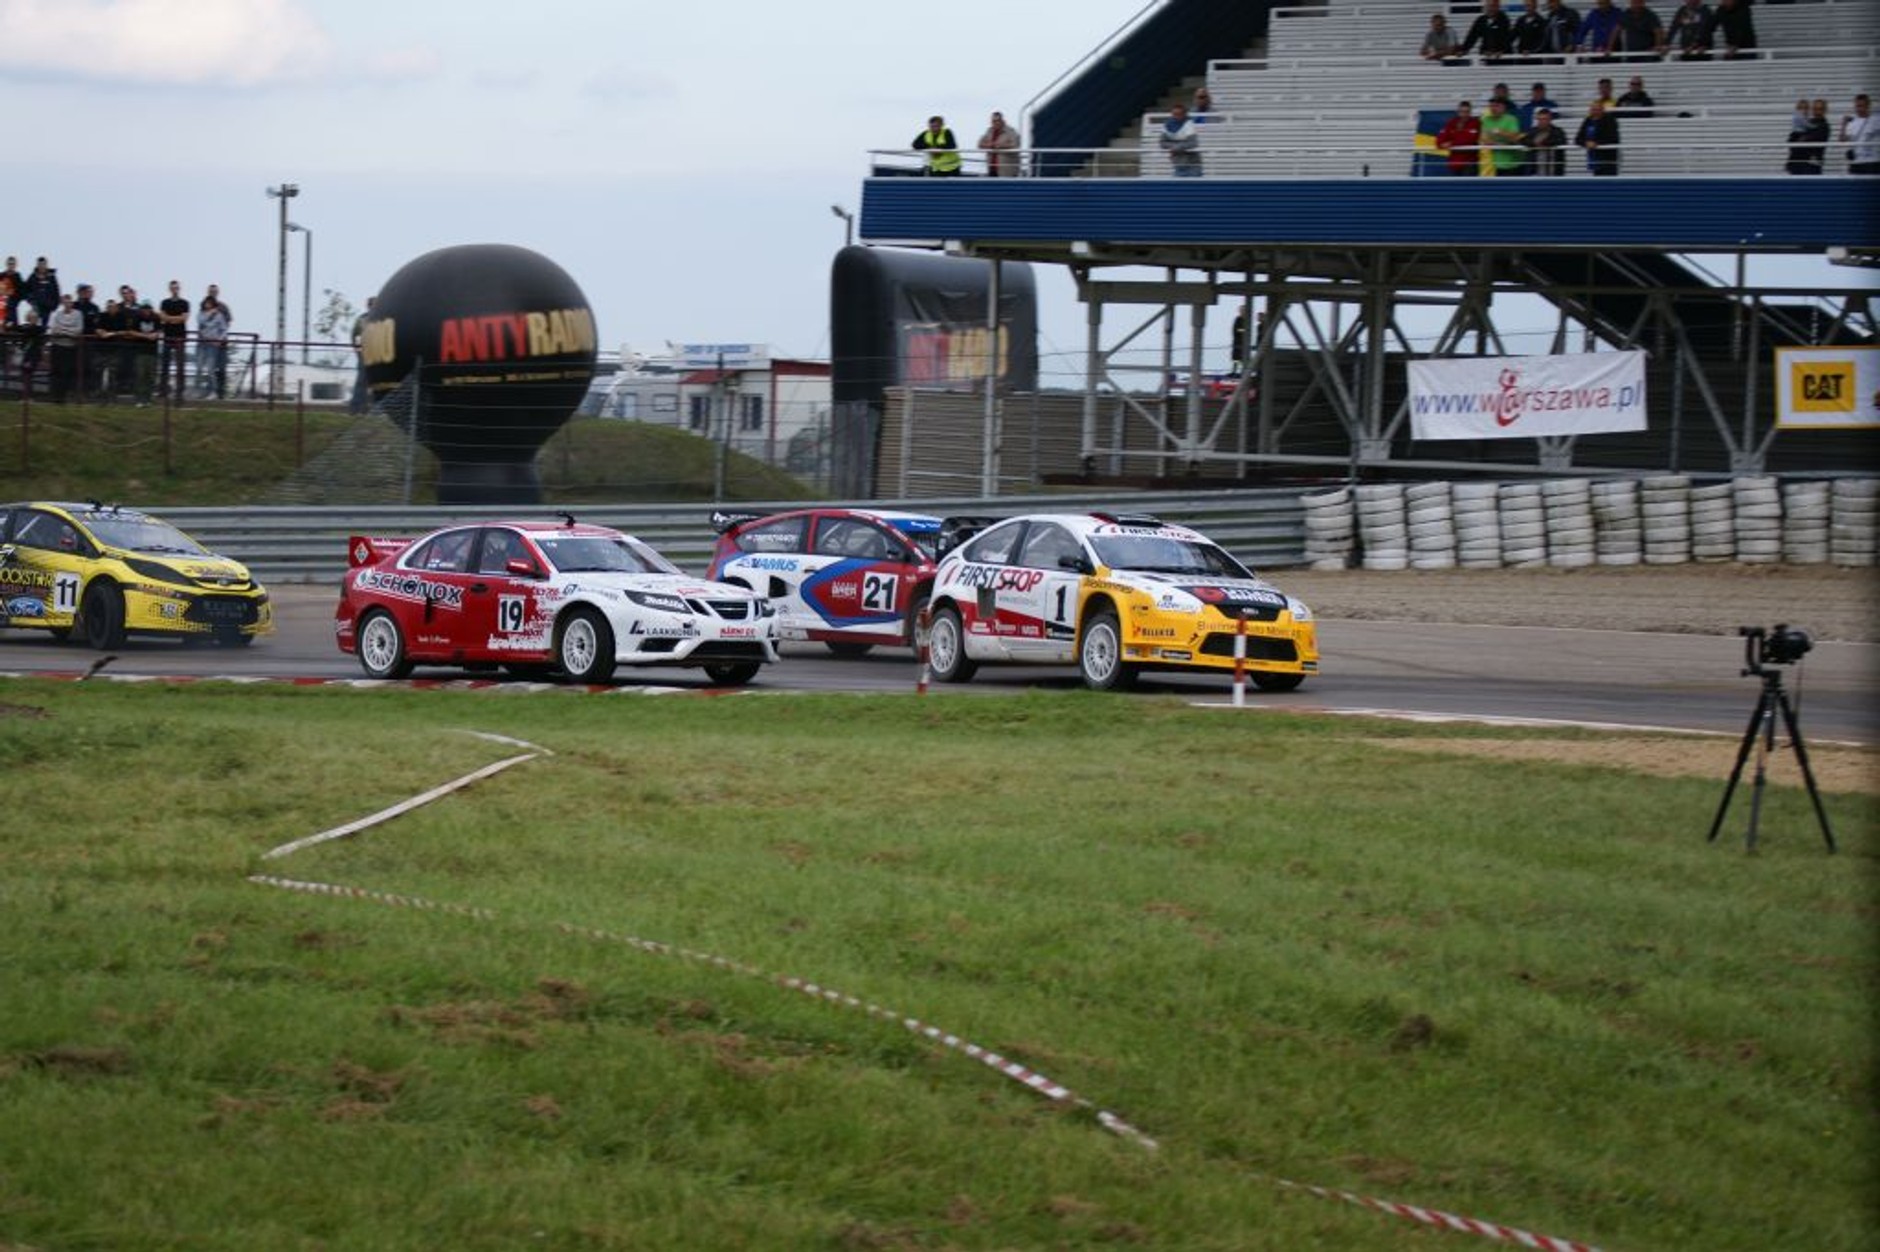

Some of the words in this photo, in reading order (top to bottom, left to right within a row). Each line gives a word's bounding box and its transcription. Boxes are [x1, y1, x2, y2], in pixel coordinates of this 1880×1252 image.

[1414, 374, 1641, 420] www.warszawa.pl
[1803, 374, 1845, 400] CAT
[57, 578, 77, 606] 11
[369, 572, 462, 604] SCHÖNOX
[863, 576, 895, 610] 21
[1056, 585, 1067, 621] 1
[500, 600, 522, 631] 19
